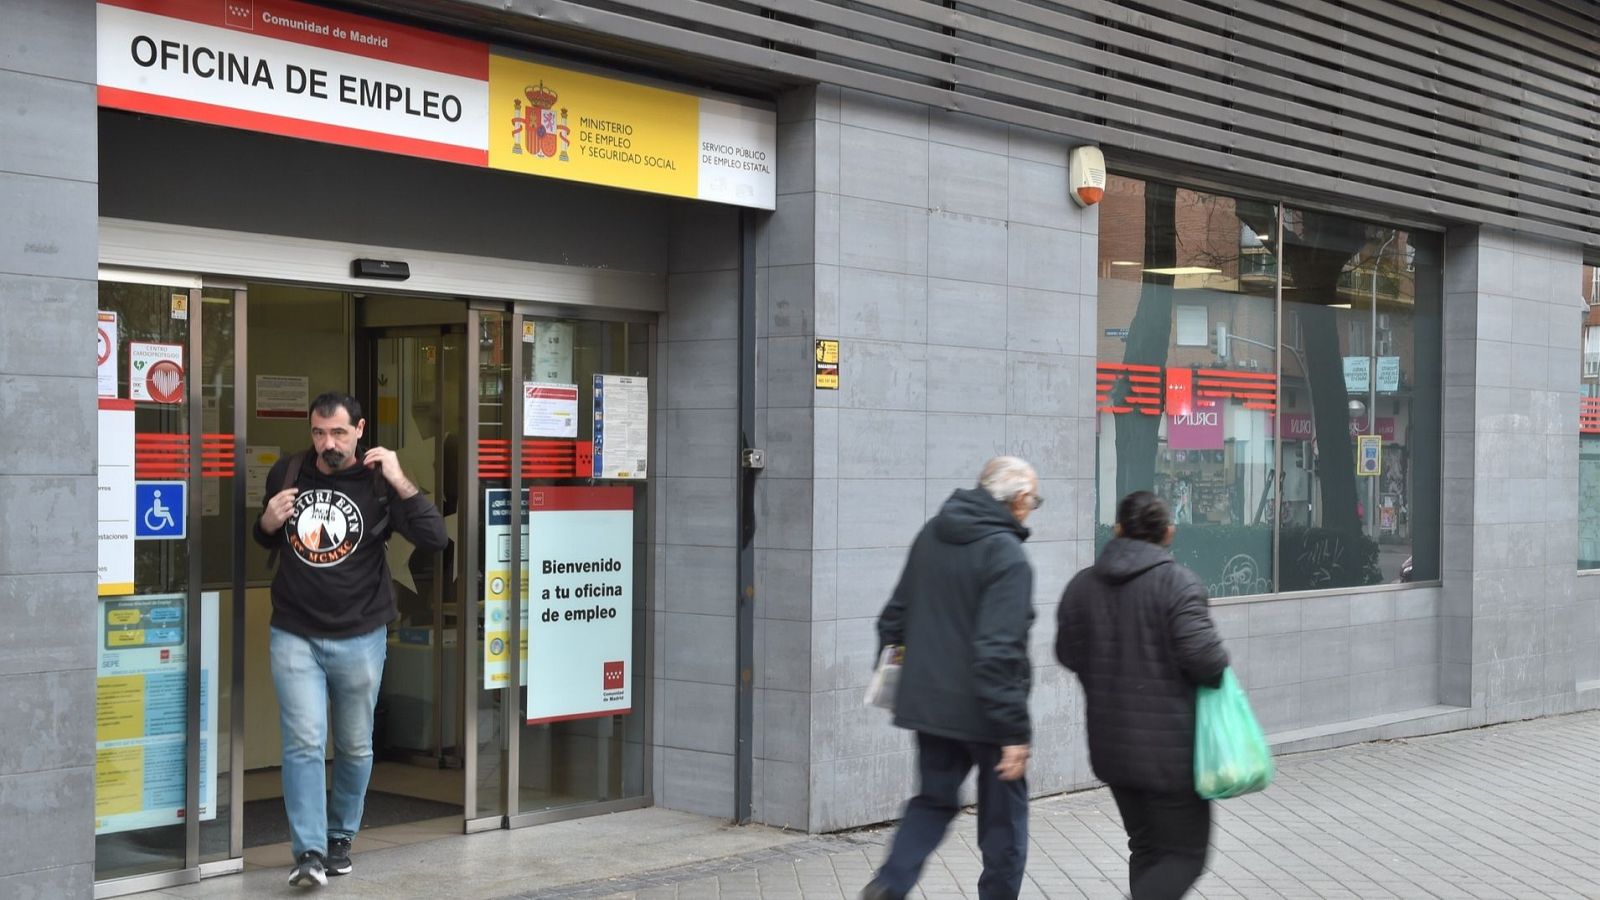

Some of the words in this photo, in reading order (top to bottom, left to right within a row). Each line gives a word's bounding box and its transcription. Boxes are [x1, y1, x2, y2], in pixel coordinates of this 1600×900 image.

[262, 11, 330, 36] Comunidad
[332, 26, 347, 39] de
[350, 30, 389, 48] Madrid
[131, 35, 274, 90] OFICINA
[286, 64, 328, 99] DE
[339, 74, 462, 123] EMPLEO
[580, 116, 633, 136] MINISTERIO
[580, 131, 593, 143] DE
[595, 133, 631, 149] EMPLEO
[580, 144, 586, 155] Y
[588, 146, 642, 165] SEGURIDAD
[644, 155, 676, 170] SOCIAL
[702, 142, 734, 155] SERVICIO
[735, 147, 766, 161] PÚBLICO
[702, 154, 712, 165] DE
[713, 156, 741, 169] EMPLEO
[743, 161, 770, 174] ESTATAL
[542, 558, 622, 574] Bienvenido
[542, 588, 550, 600] a
[555, 585, 570, 599] tu
[575, 583, 622, 598] oficina
[541, 608, 559, 622] de
[564, 605, 617, 623] empleo
